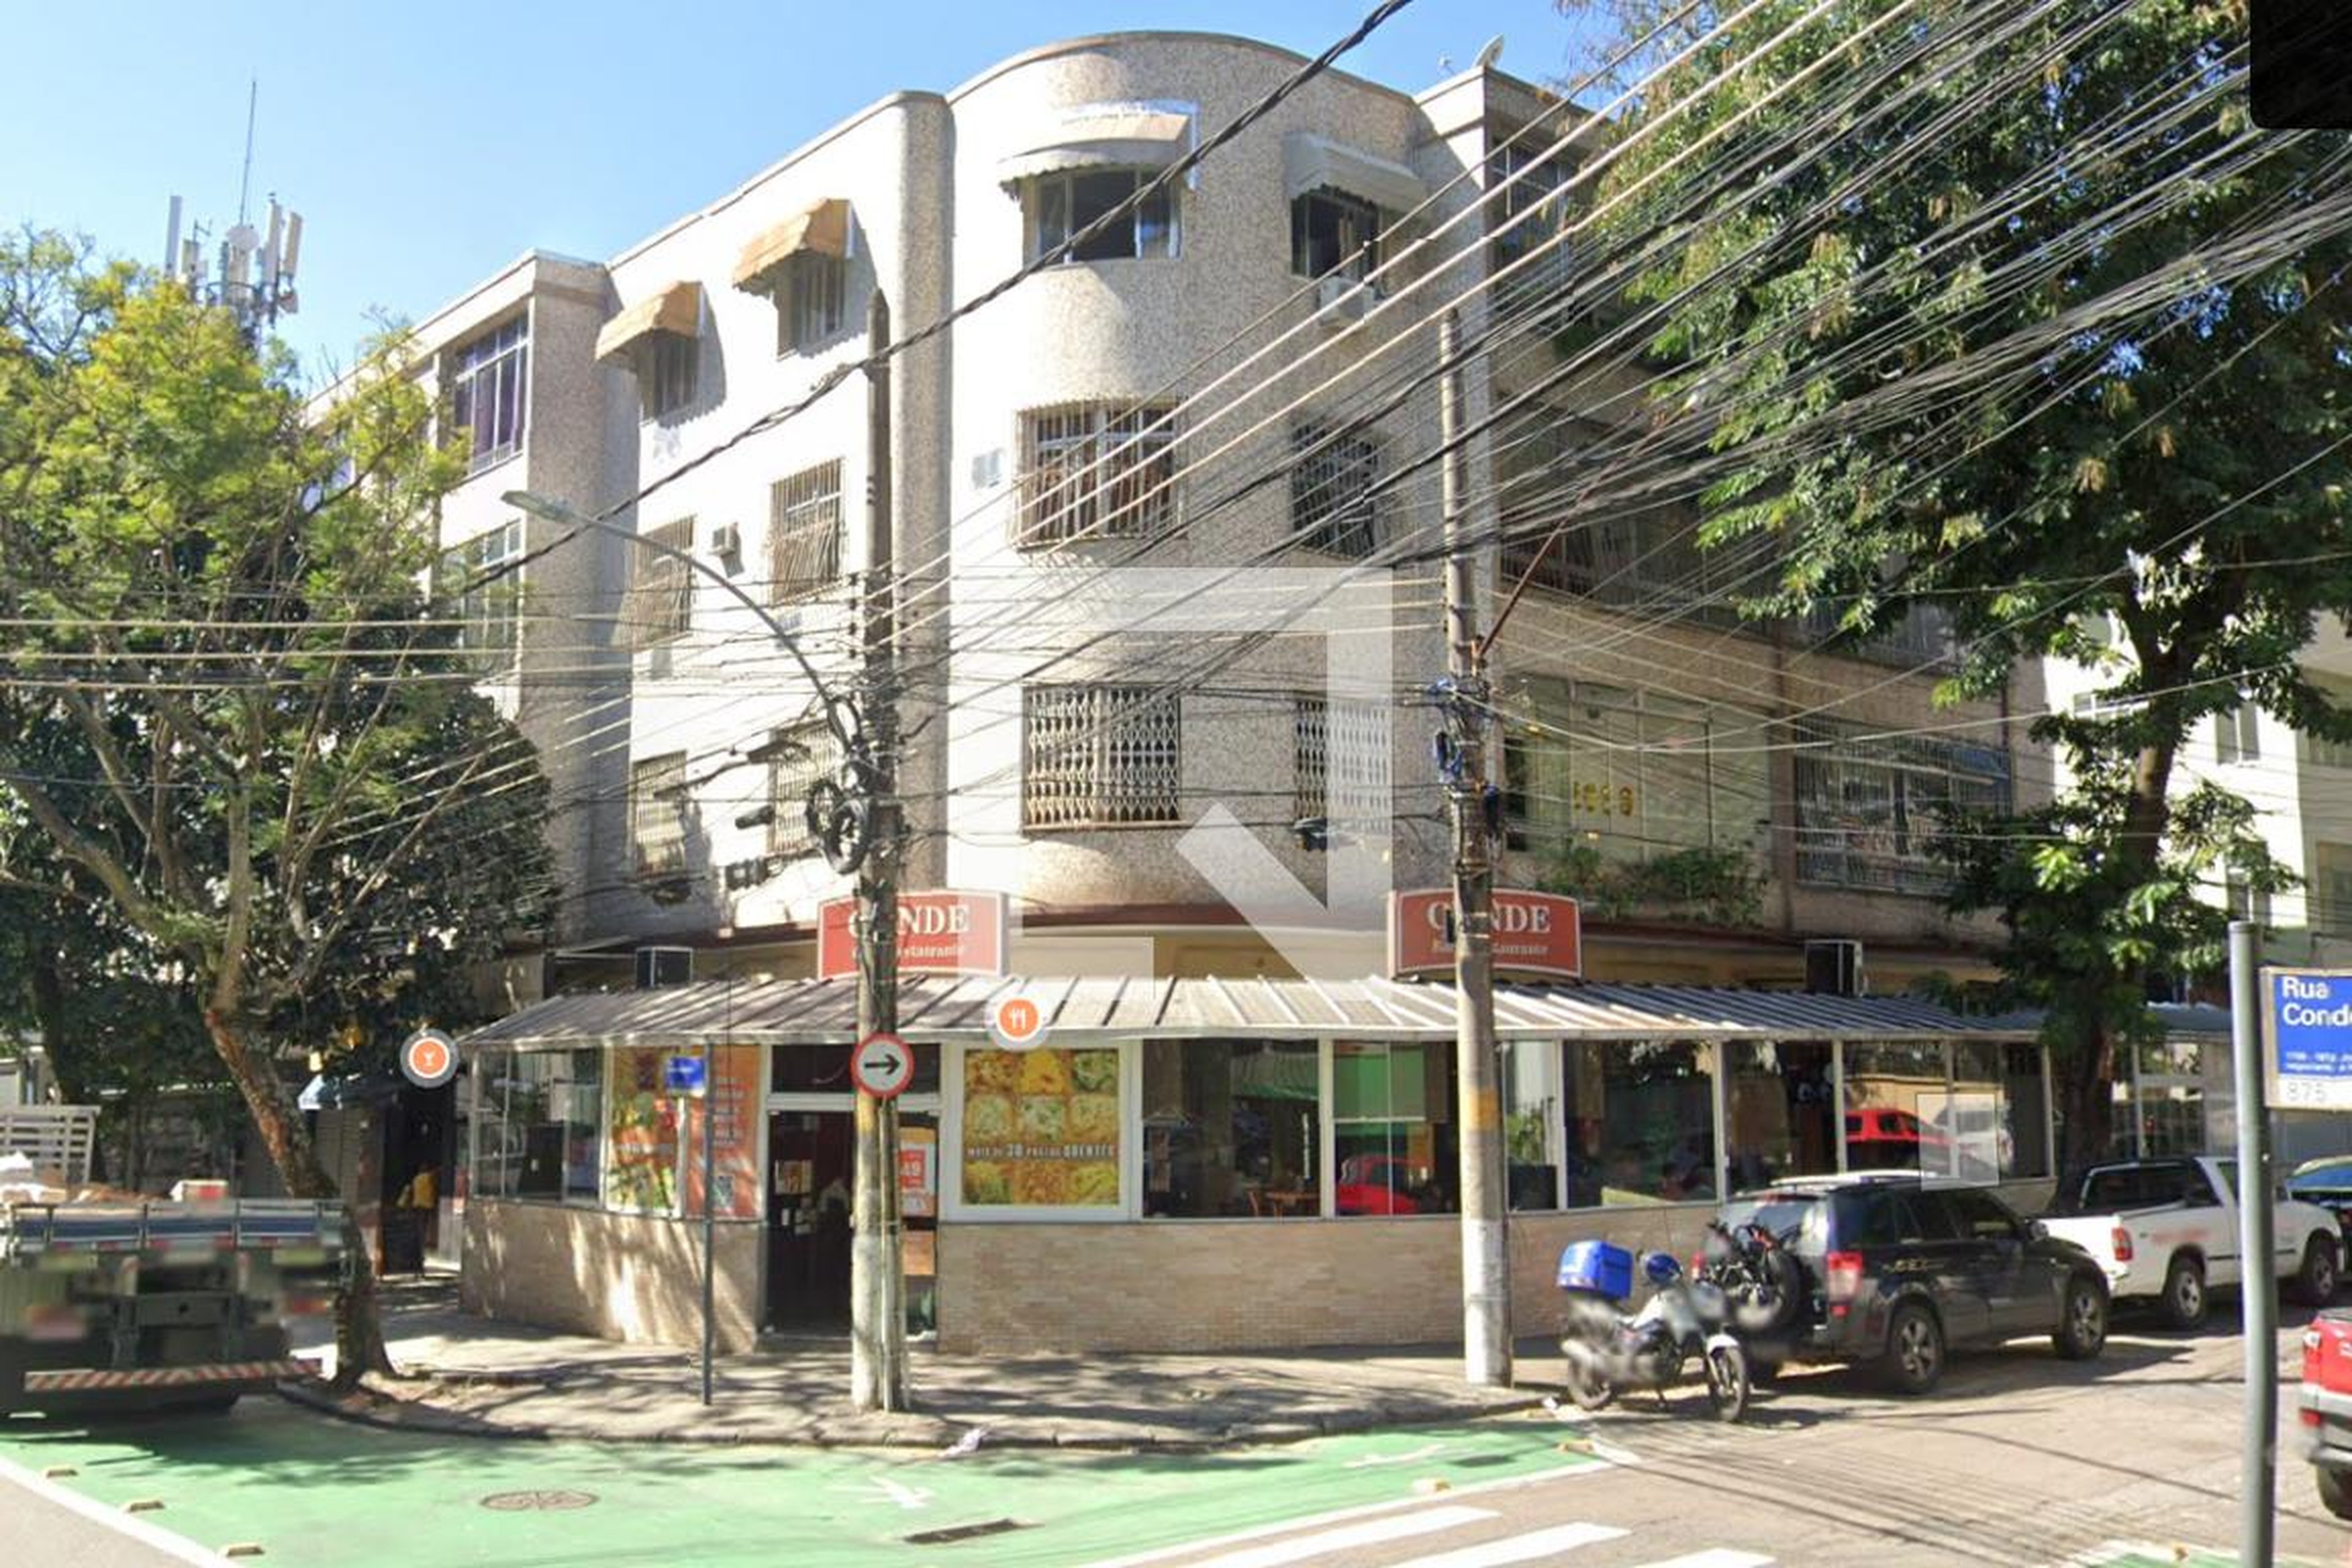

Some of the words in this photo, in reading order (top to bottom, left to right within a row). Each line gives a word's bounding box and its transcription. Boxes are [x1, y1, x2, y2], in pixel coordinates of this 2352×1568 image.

[848, 903, 969, 937] CNDE
[1427, 900, 1551, 933] CDE
[2282, 976, 2329, 999] Rua
[2283, 1003, 2352, 1027] Cond
